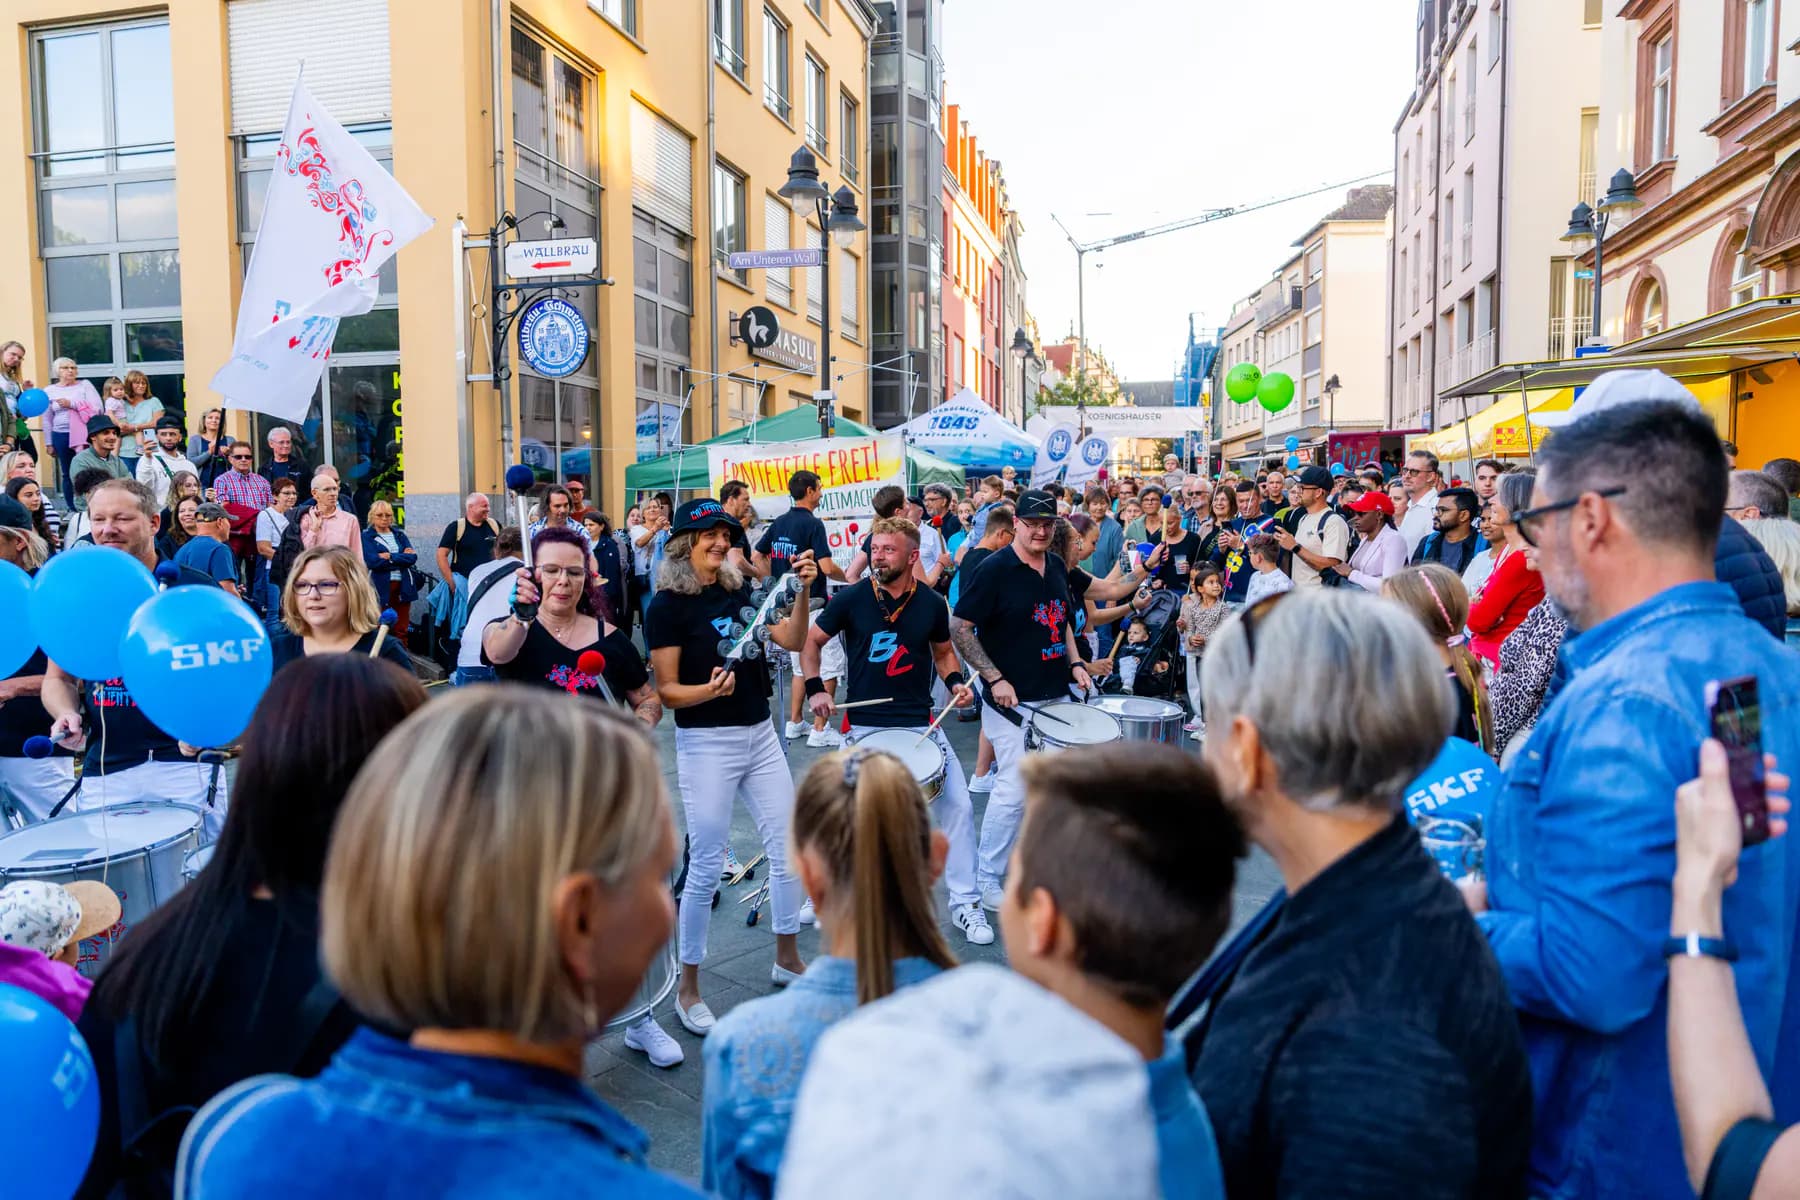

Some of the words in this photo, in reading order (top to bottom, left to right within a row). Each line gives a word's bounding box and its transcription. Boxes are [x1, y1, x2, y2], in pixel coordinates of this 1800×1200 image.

[734, 256, 751, 266] Am
[753, 255, 792, 265] Unteren
[794, 251, 816, 264] Wall
[928, 415, 980, 430] 1848
[828, 440, 881, 487] FREI!
[170, 638, 264, 671] SKF
[1407, 767, 1485, 817] SKF
